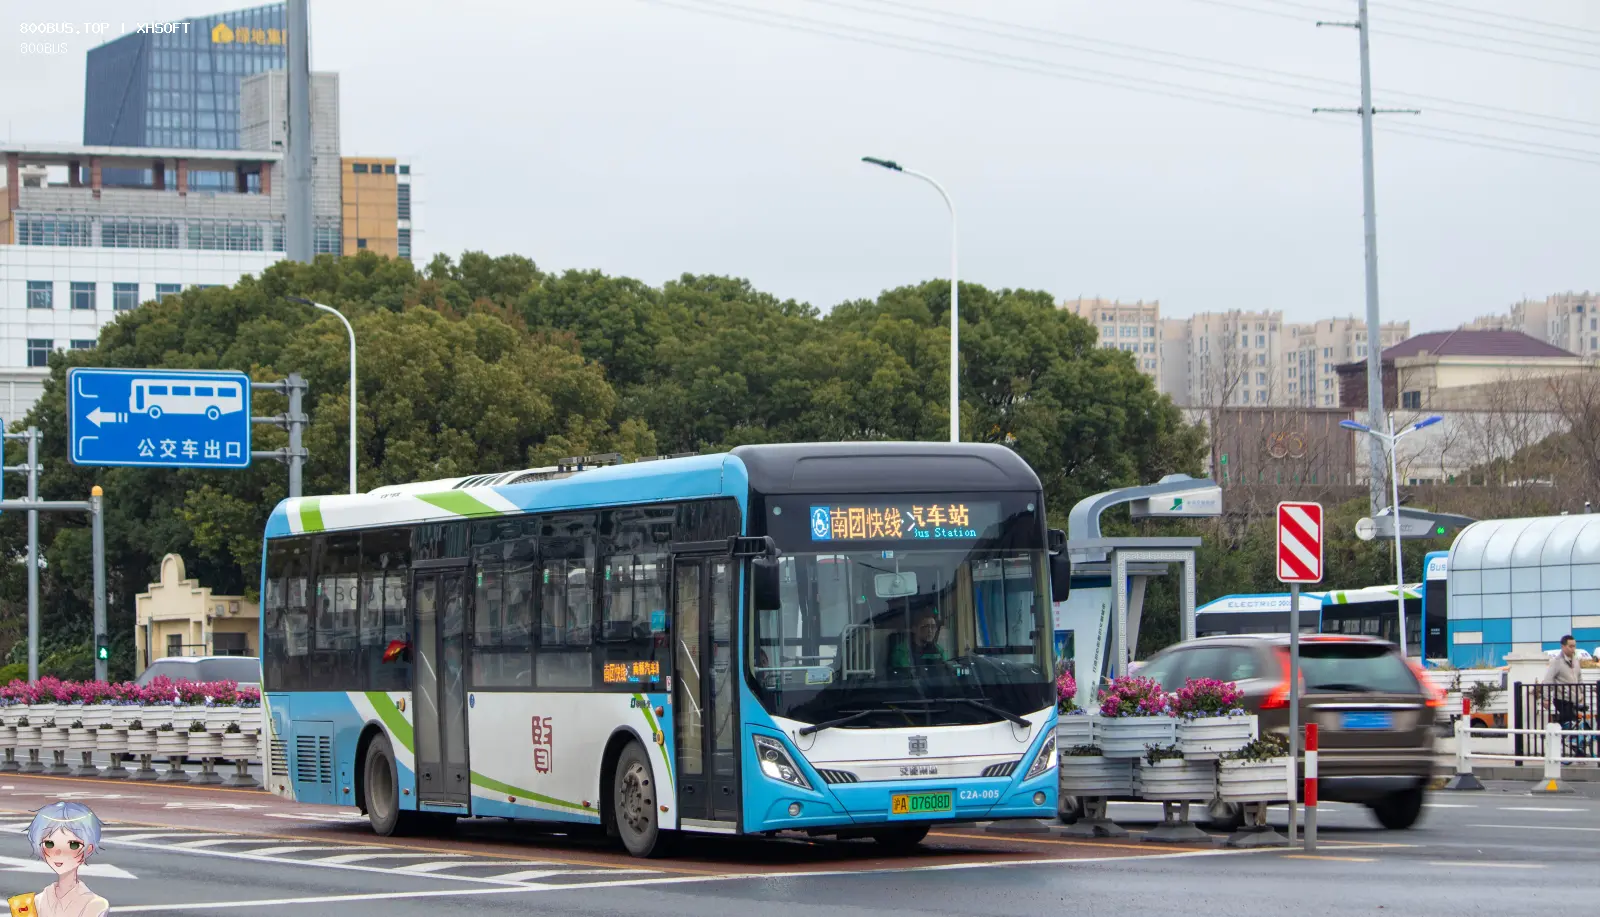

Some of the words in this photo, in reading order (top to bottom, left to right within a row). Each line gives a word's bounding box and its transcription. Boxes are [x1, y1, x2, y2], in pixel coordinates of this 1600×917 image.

[137, 438, 241, 459] 公交车出口
[830, 507, 903, 539] 南团快线
[912, 504, 969, 527] 汽车站
[934, 527, 977, 538] Station
[1228, 600, 1277, 608] ELECTRIC
[960, 790, 999, 800] C2A-005
